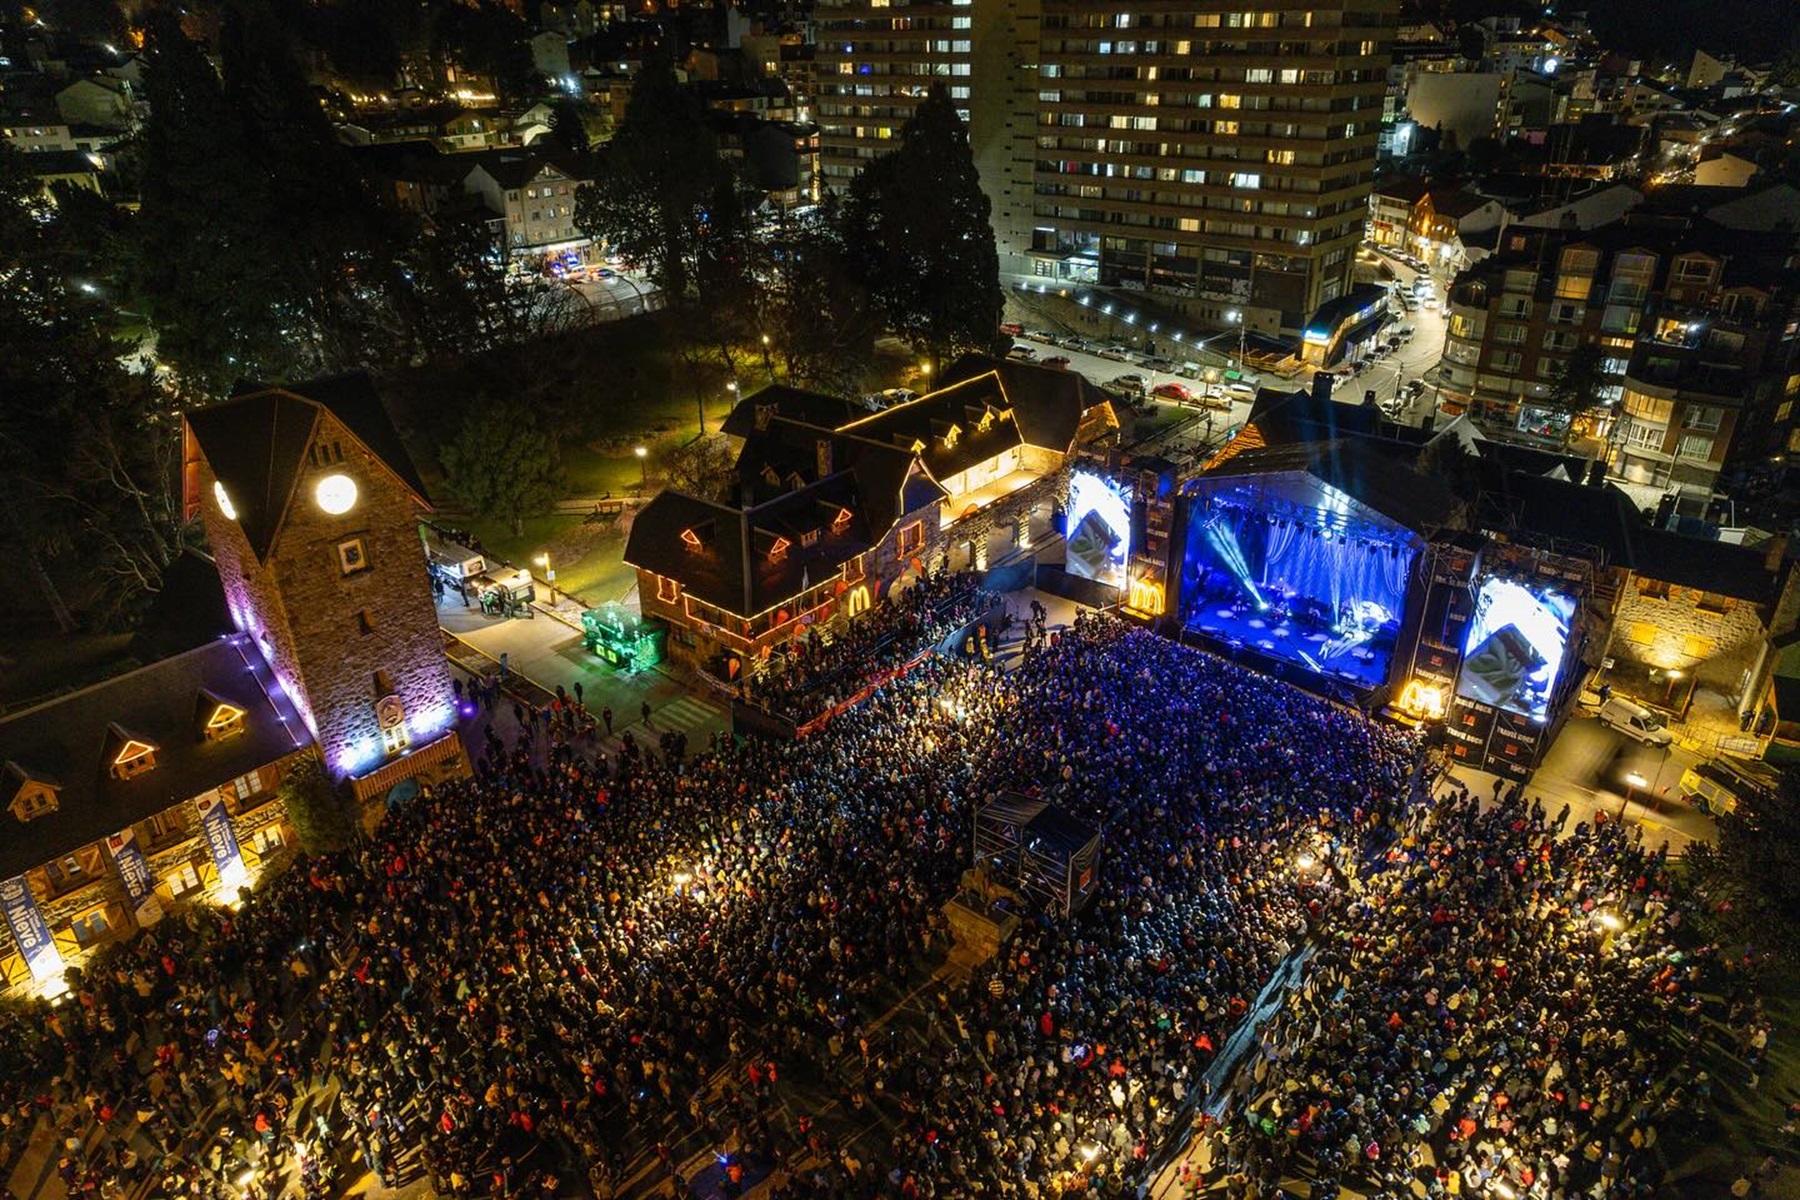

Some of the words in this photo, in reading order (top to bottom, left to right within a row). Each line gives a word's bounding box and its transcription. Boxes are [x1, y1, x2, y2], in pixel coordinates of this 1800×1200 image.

[849, 585, 870, 617] M
[206, 818, 227, 859] Nieve
[118, 855, 141, 897] Nieve
[8, 904, 37, 949] Nieve
